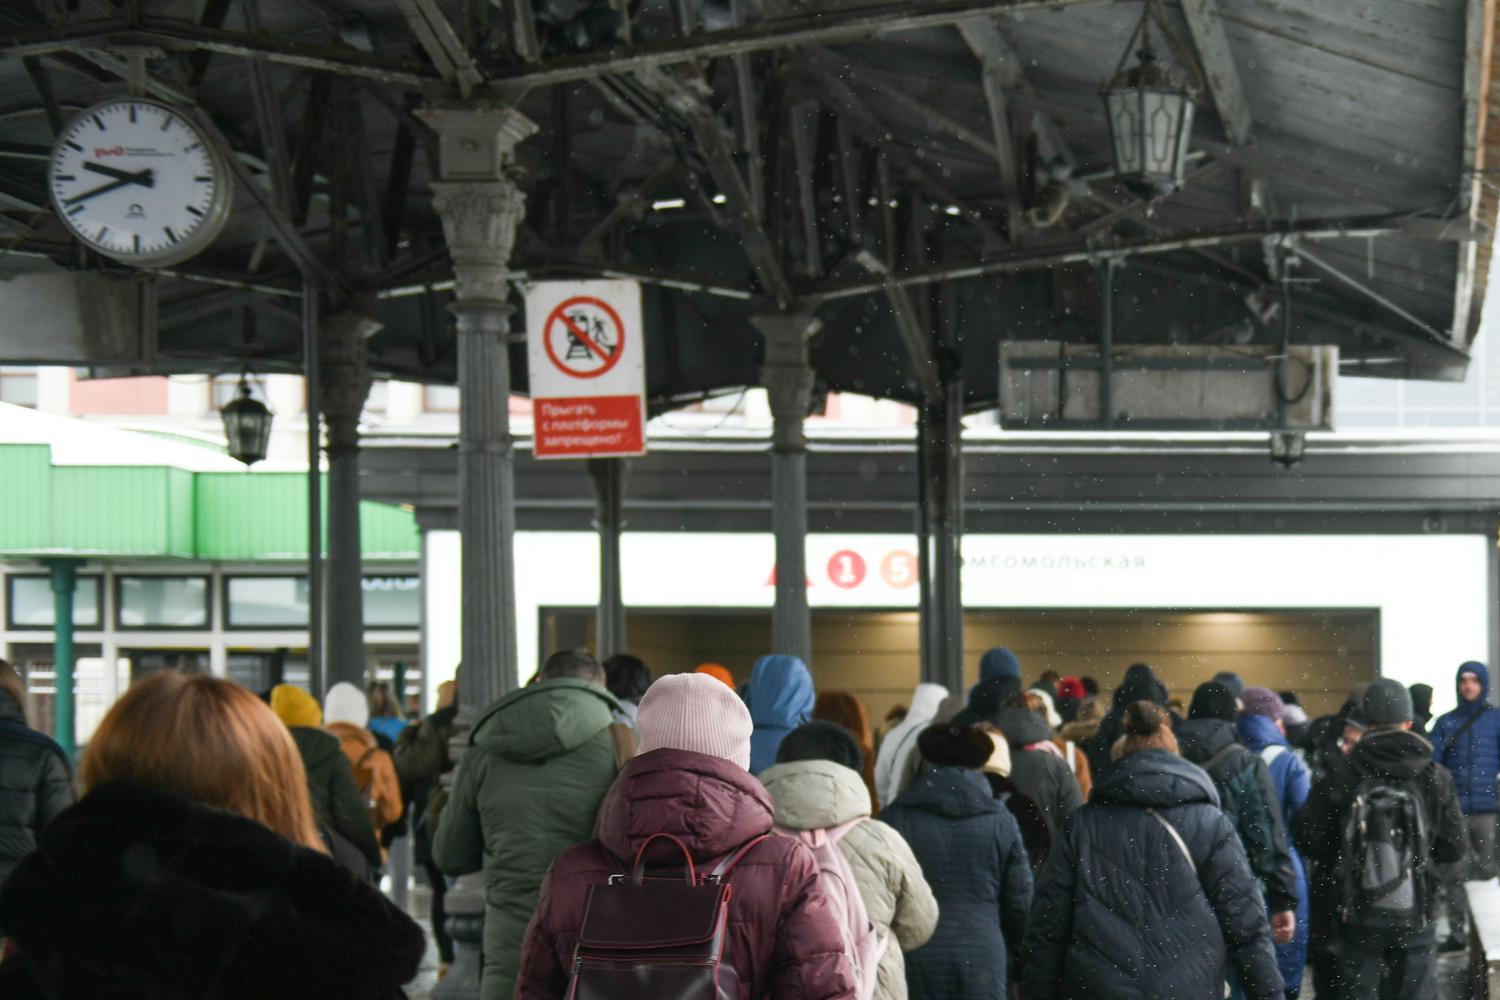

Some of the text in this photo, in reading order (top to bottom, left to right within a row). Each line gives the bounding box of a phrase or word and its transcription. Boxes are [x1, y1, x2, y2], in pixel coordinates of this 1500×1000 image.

[541, 403, 597, 417] Прыгать
[542, 418, 628, 432] с платформы
[543, 433, 623, 448] запрещено!
[959, 555, 1147, 569] мсомольская
